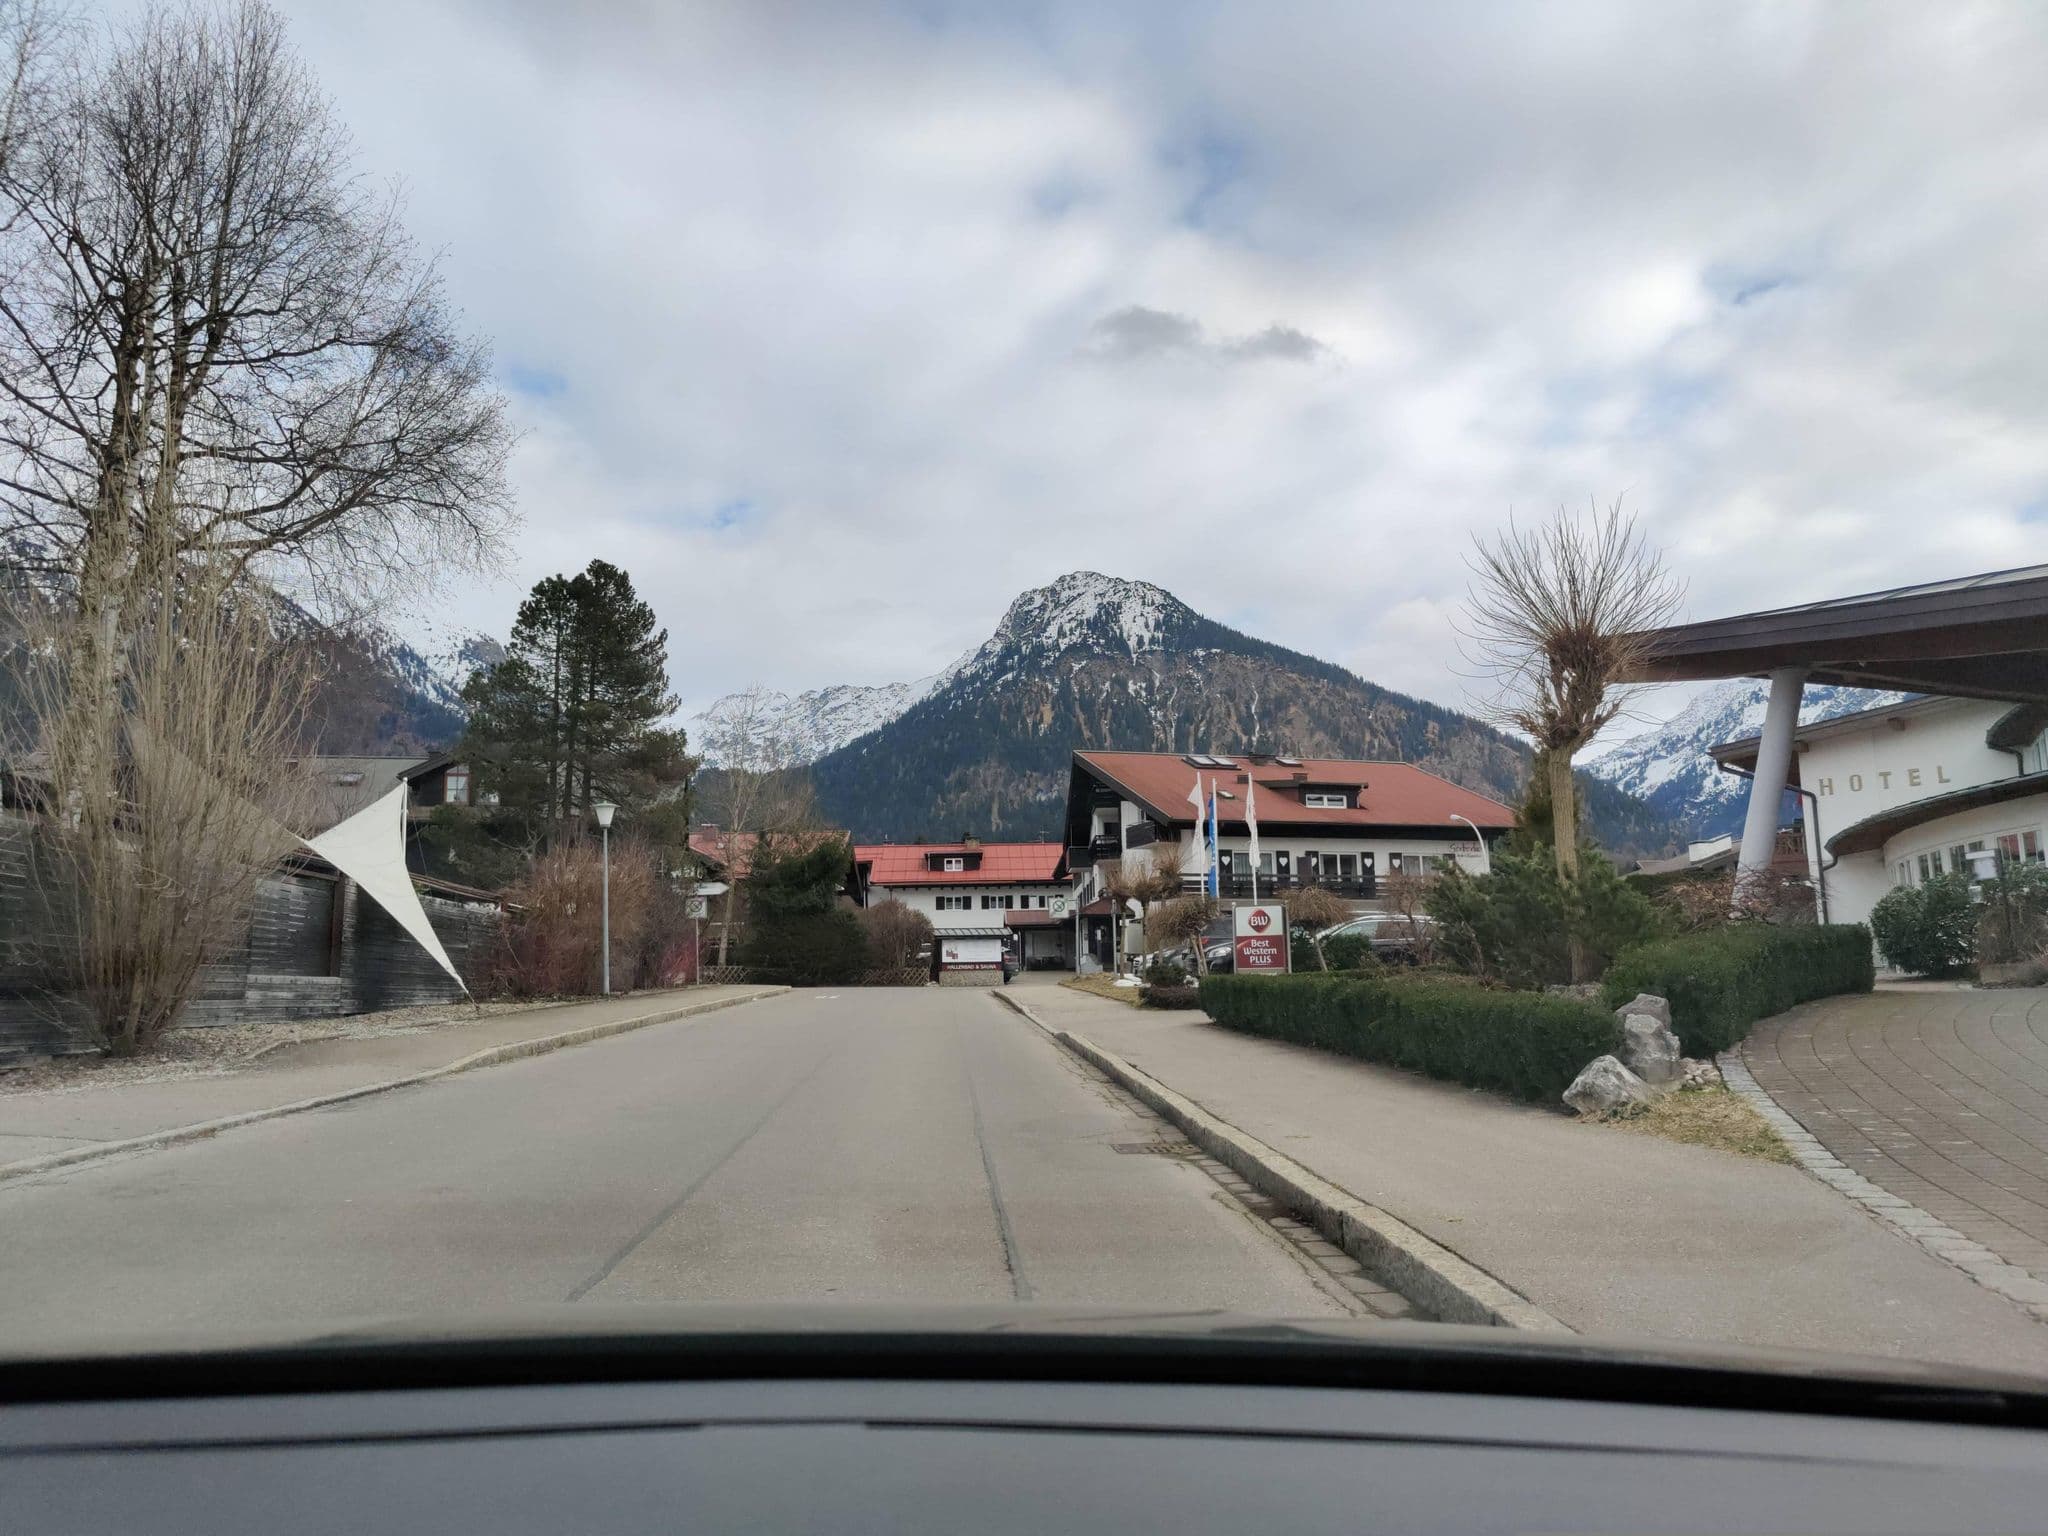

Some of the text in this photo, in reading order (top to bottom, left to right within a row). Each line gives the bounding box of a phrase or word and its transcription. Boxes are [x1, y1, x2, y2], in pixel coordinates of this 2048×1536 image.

[1818, 765, 1952, 796] HOTEL
[1250, 916, 1268, 926] BW
[1251, 939, 1270, 948] Best
[1243, 947, 1277, 955] Western
[1249, 955, 1272, 964] PLUS
